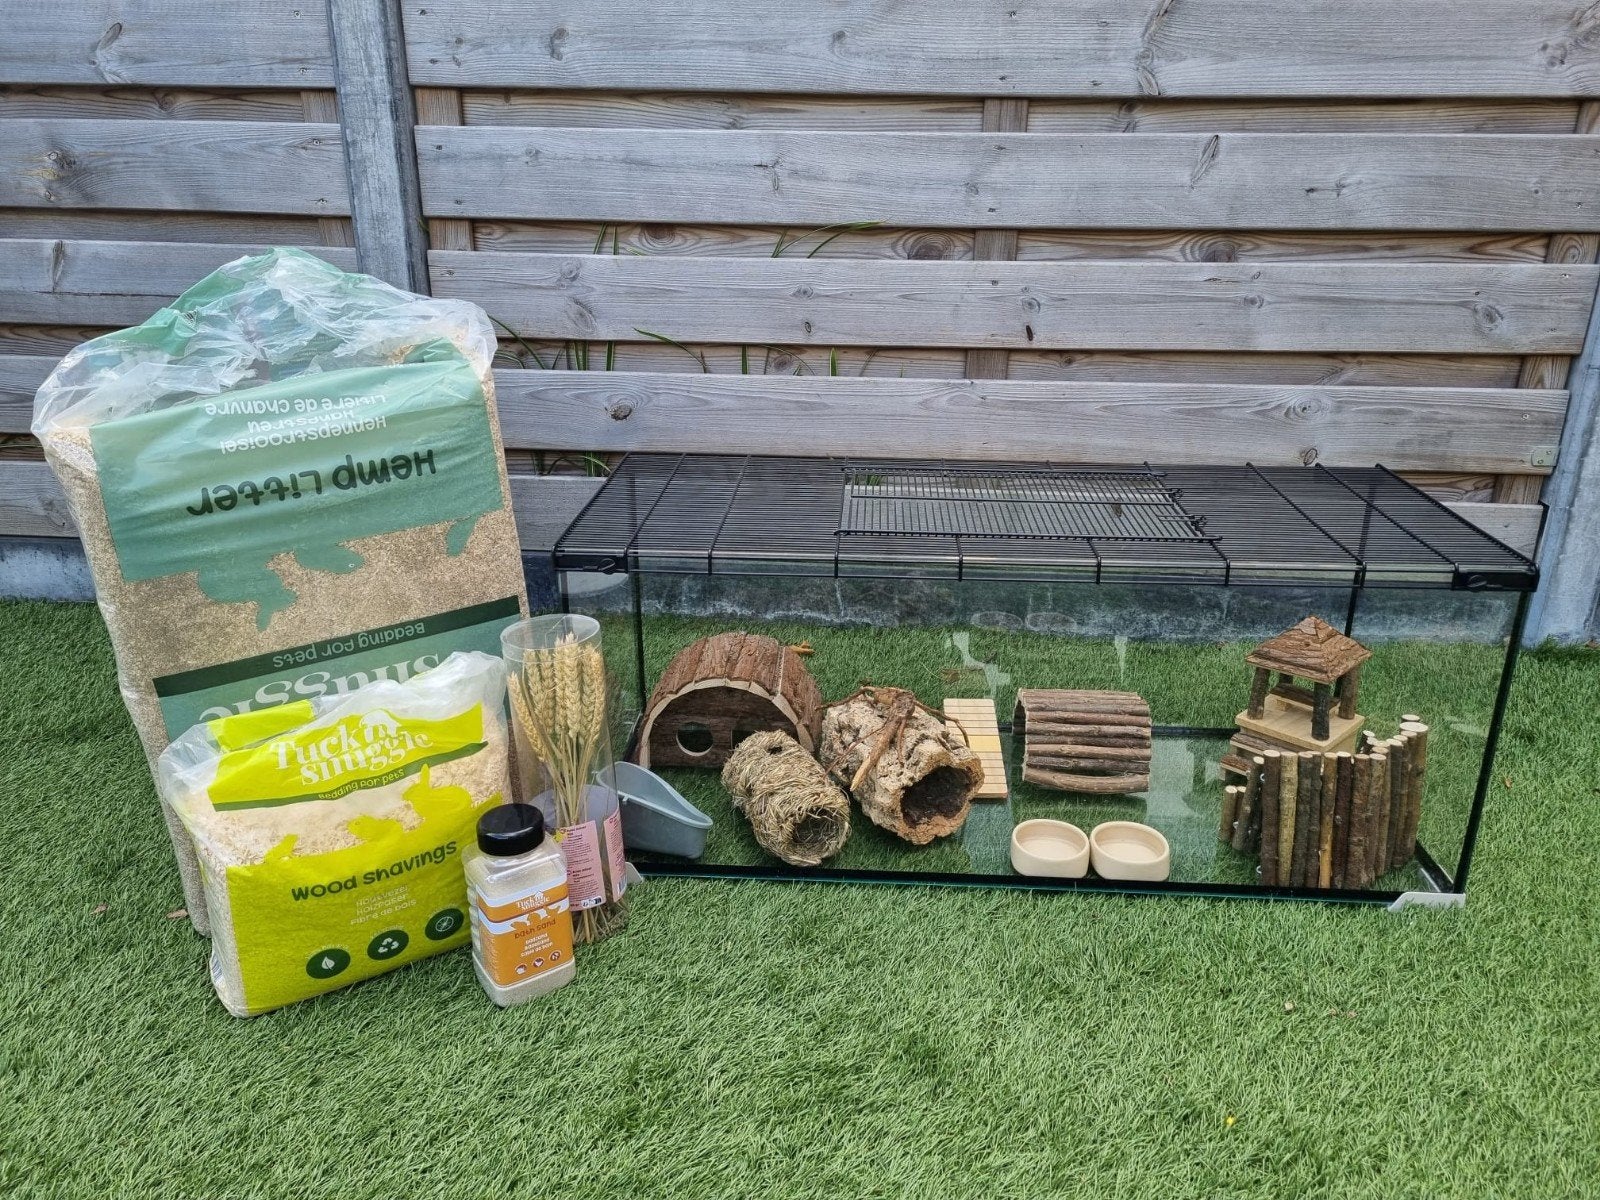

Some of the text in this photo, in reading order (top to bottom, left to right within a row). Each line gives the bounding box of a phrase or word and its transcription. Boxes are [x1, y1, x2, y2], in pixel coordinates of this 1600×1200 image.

[205, 398, 291, 417] chanvre
[294, 397, 319, 414] de
[219, 415, 388, 455] Hennepstrooisel
[186, 449, 437, 516] Hemp Litter
[273, 622, 426, 669] Bedding for pets
[300, 731, 434, 786] snuggle
[317, 768, 405, 800] Bedding for pets
[291, 840, 458, 902] wood shavings
[536, 918, 556, 931] sand
